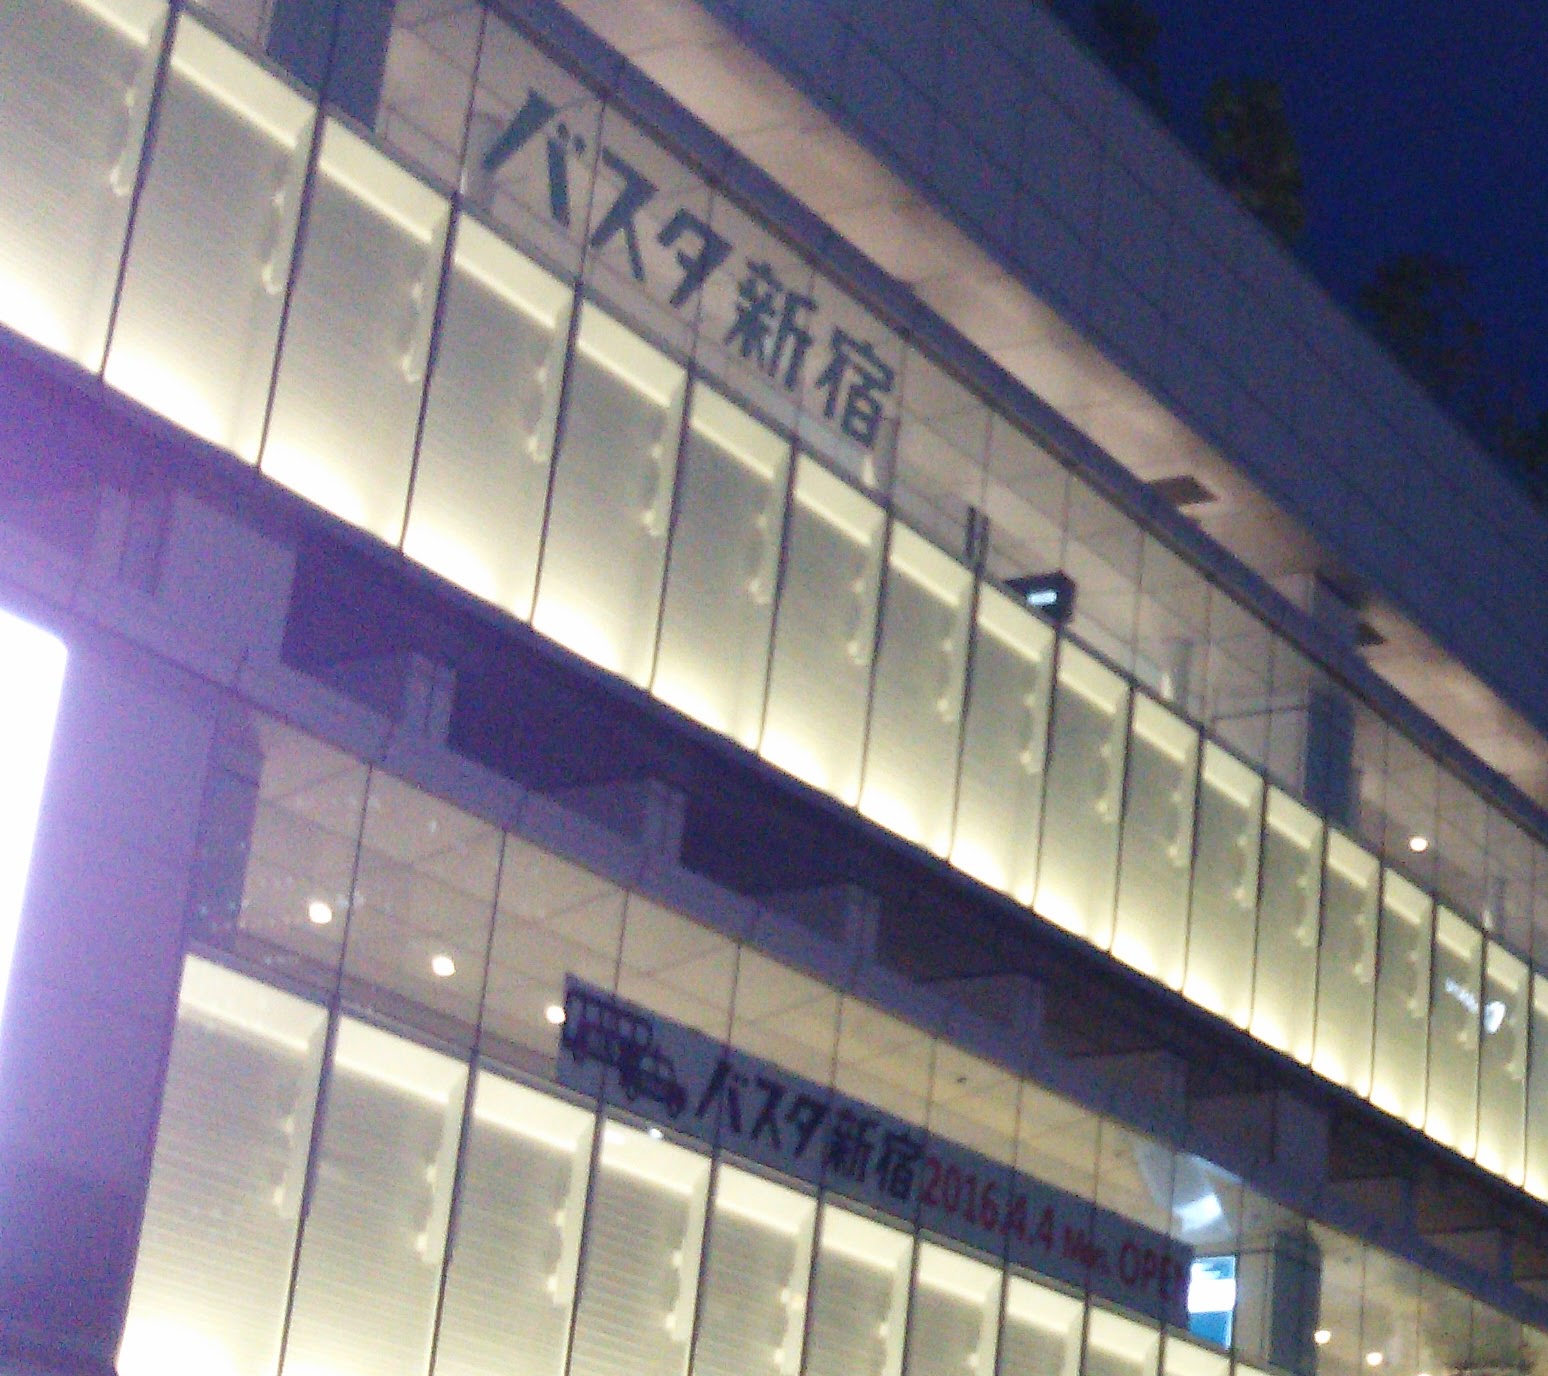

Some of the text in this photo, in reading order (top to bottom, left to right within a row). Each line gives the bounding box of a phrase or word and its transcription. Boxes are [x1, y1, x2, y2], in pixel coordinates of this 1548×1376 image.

[482, 87, 896, 450] バスタ新宿
[694, 1059, 926, 1201] バスタ新宿
